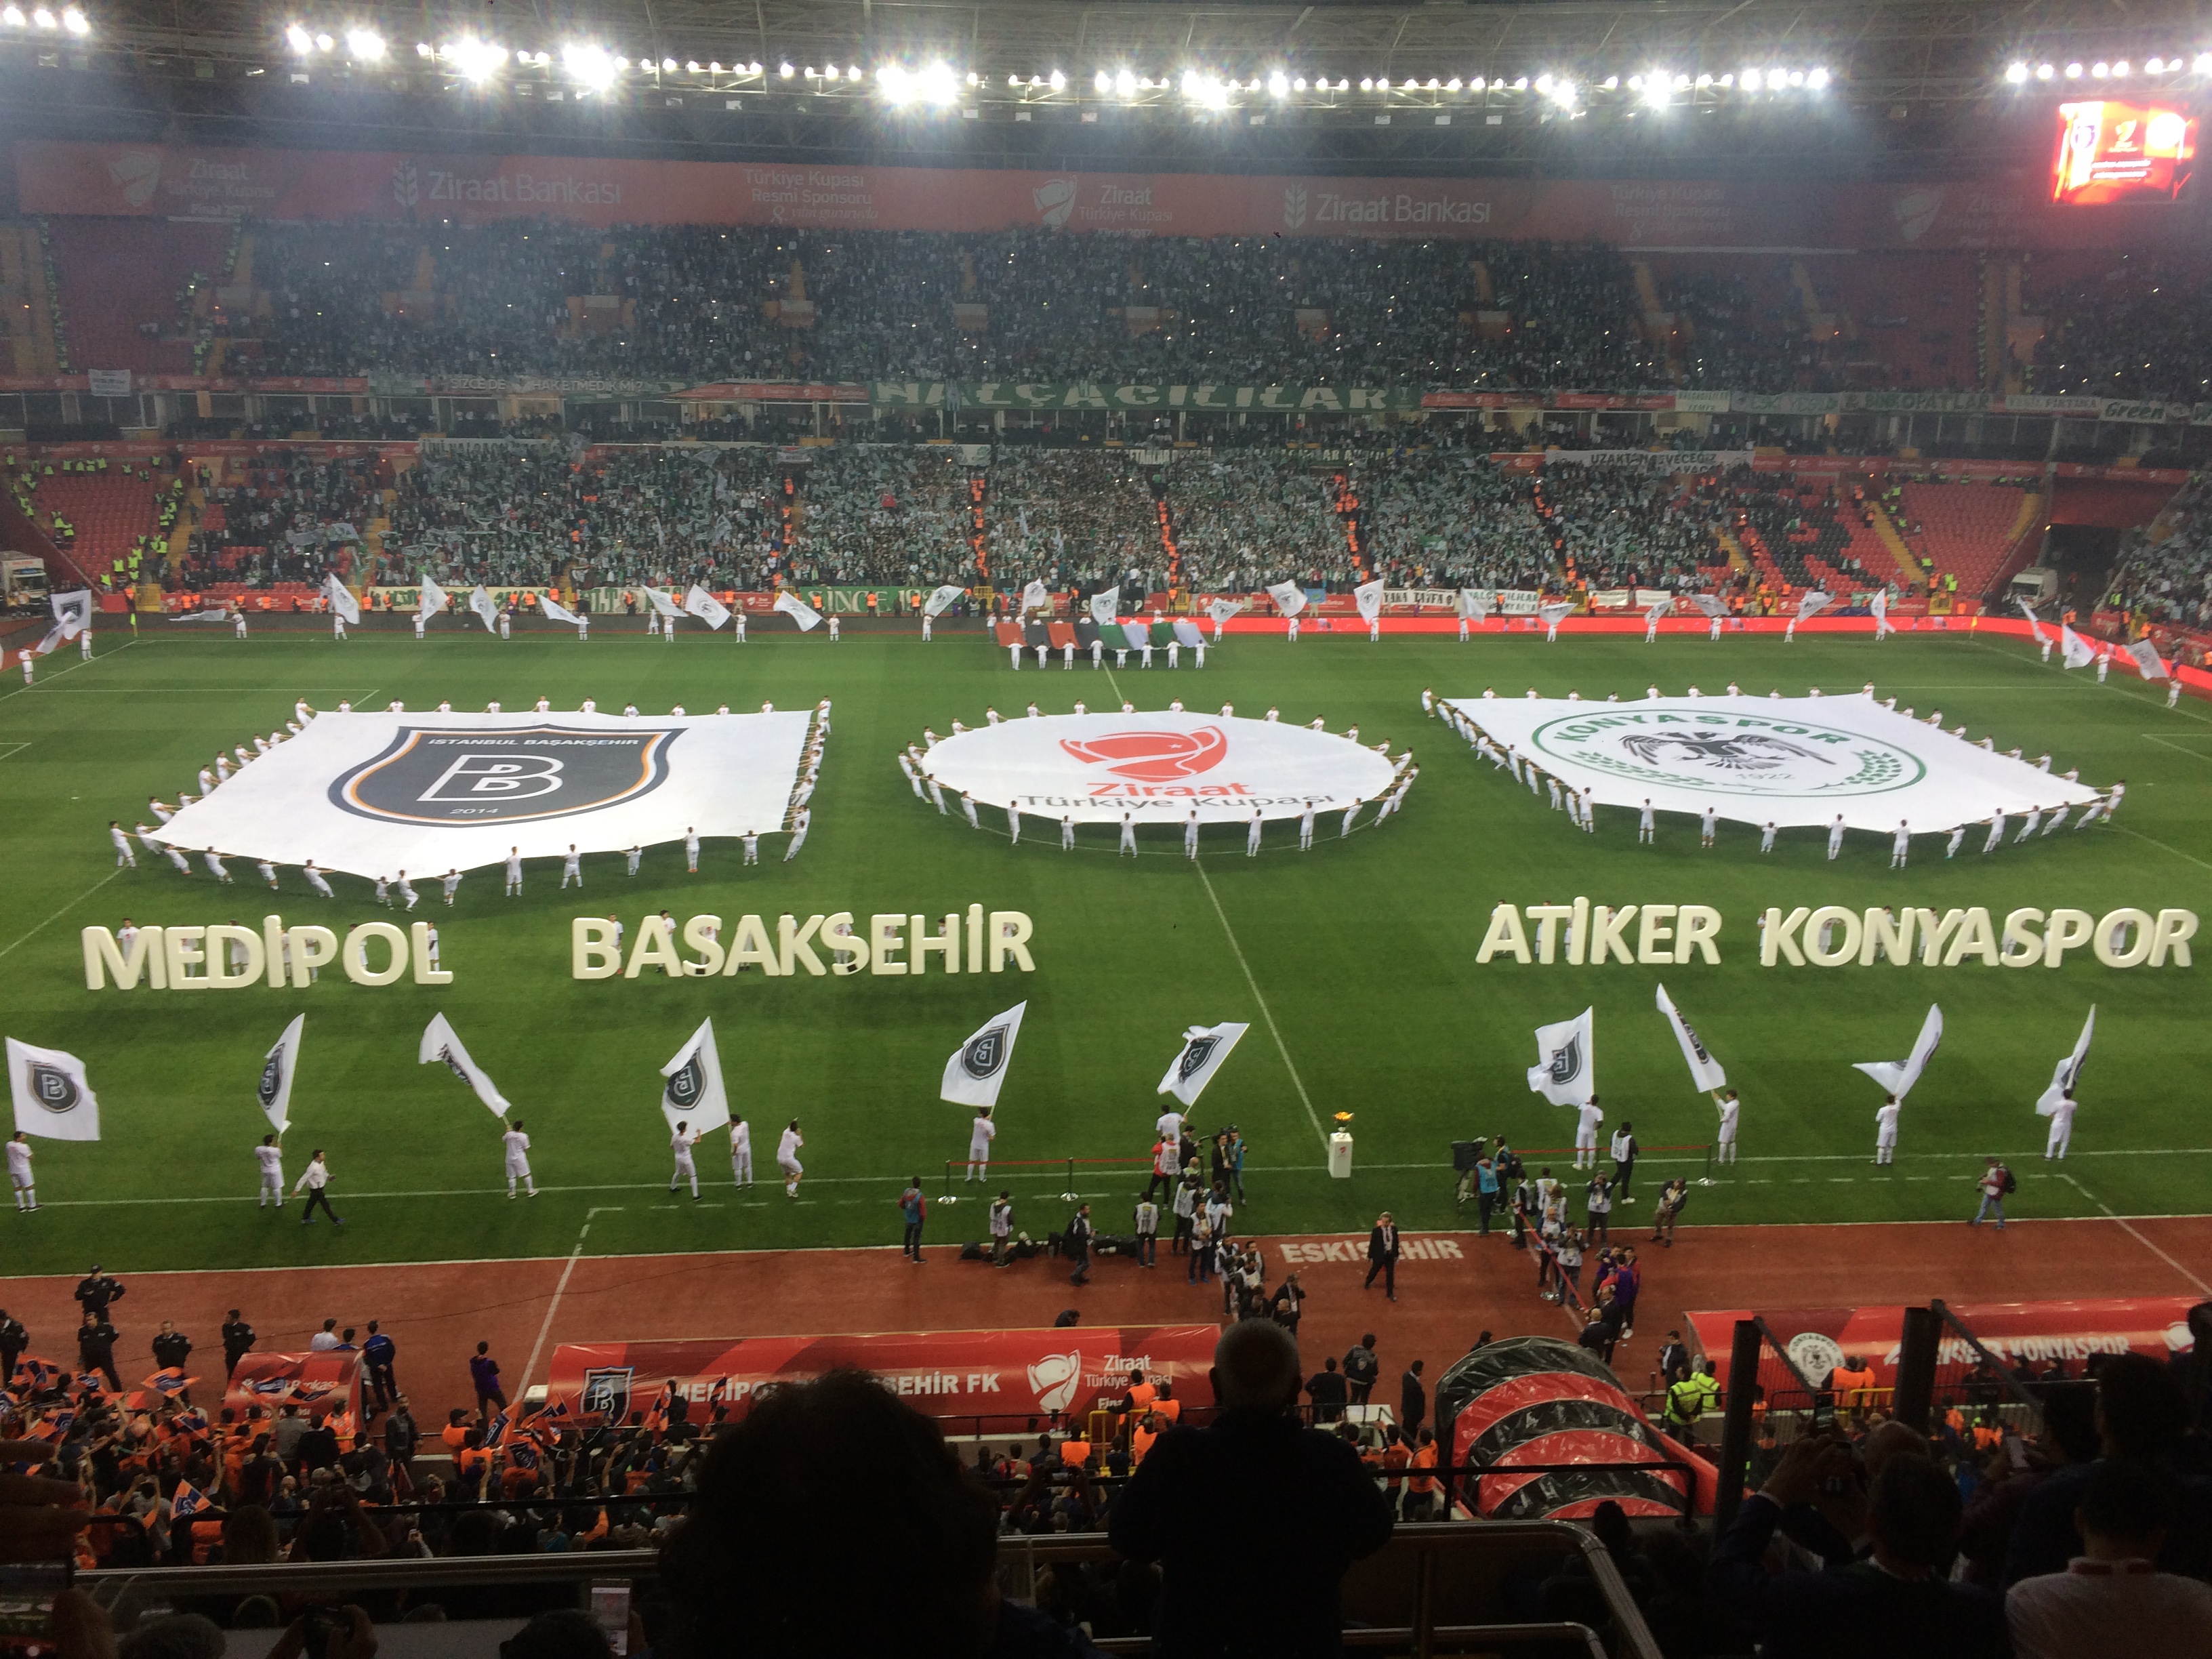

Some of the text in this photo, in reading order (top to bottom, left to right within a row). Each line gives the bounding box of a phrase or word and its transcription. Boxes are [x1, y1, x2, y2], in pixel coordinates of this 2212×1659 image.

[428, 171, 621, 204] Ziraat Bankası
[743, 169, 864, 189] Türkiye Kupası
[752, 188, 872, 206] Resmi Sponsoru
[1100, 185, 1151, 205] Ziraat
[1080, 207, 1173, 222] Türkiye Kupası
[1315, 194, 1490, 223] Ziraat Bankası
[1554, 713, 1853, 744] KONYASPOR
[1086, 783, 1255, 796] Ziraat
[1019, 795, 1334, 809] Türkiye Kupası
[1475, 897, 2200, 968] ATİKER KONYASPOR
[81, 915, 454, 990] MEDİPOL
[1103, 1354, 1152, 1371] Ziraat
[966, 1372, 1002, 1395] FK
[1084, 1374, 1128, 1389] Türkiye
